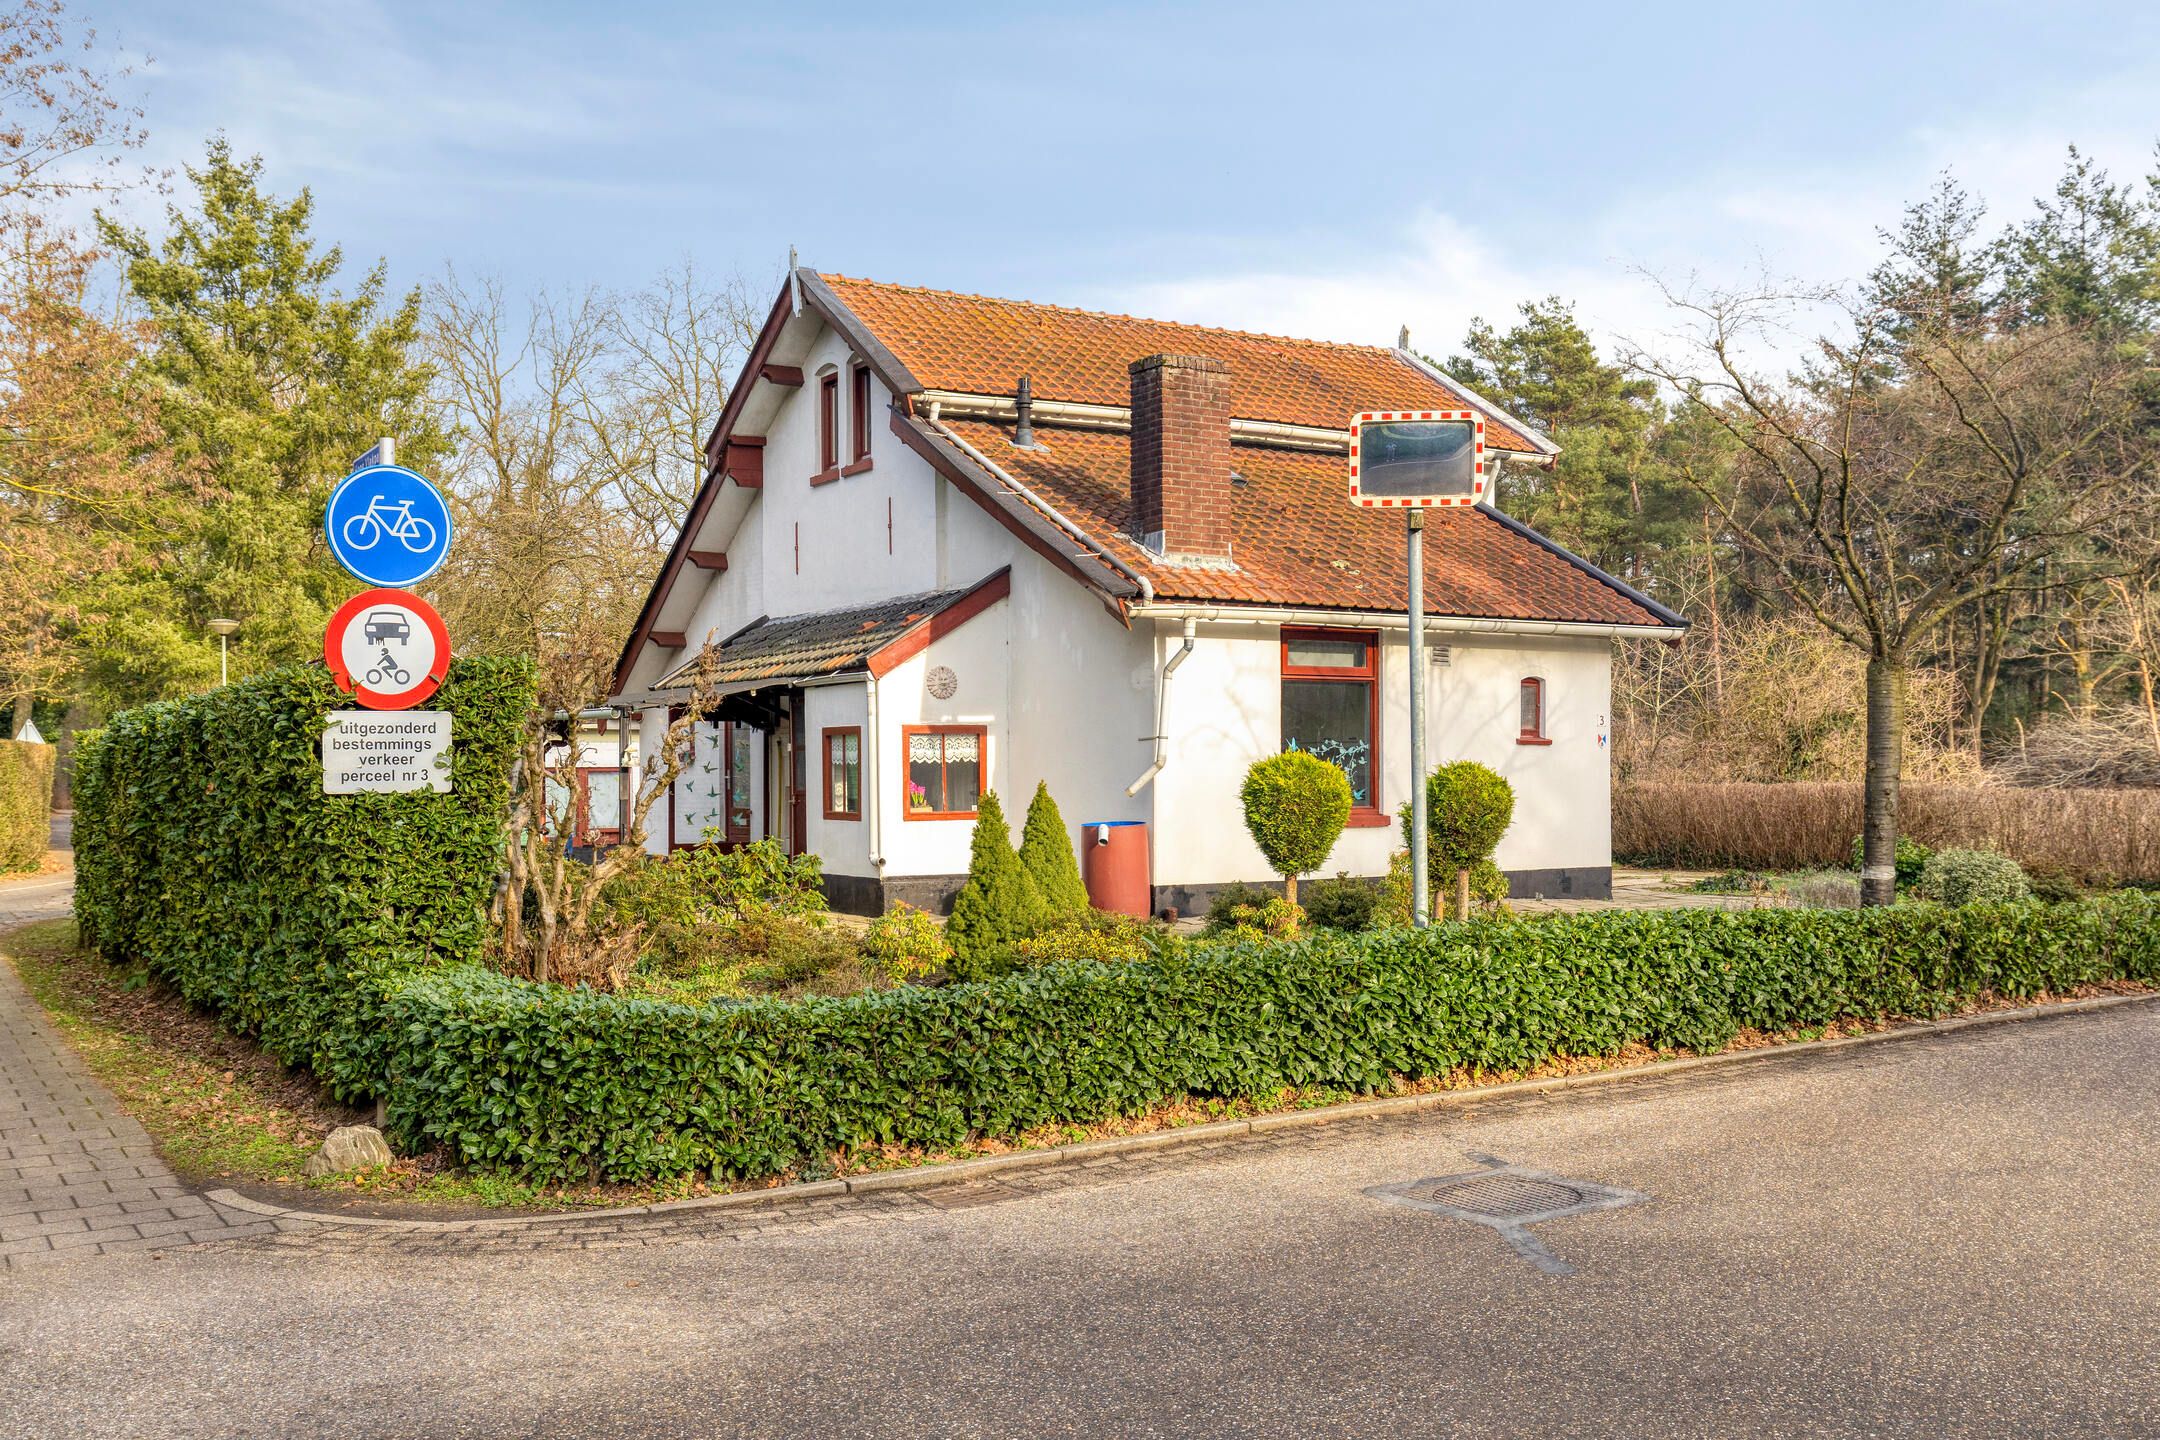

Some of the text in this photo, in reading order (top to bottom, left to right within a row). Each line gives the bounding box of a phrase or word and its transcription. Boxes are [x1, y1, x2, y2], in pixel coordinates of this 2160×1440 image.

[1599, 715, 1605, 726] 3
[340, 722, 437, 737] uitgezonderd
[332, 738, 432, 752] bestemmings
[359, 753, 416, 765] verkeer
[341, 769, 429, 784] perceel nr 3
